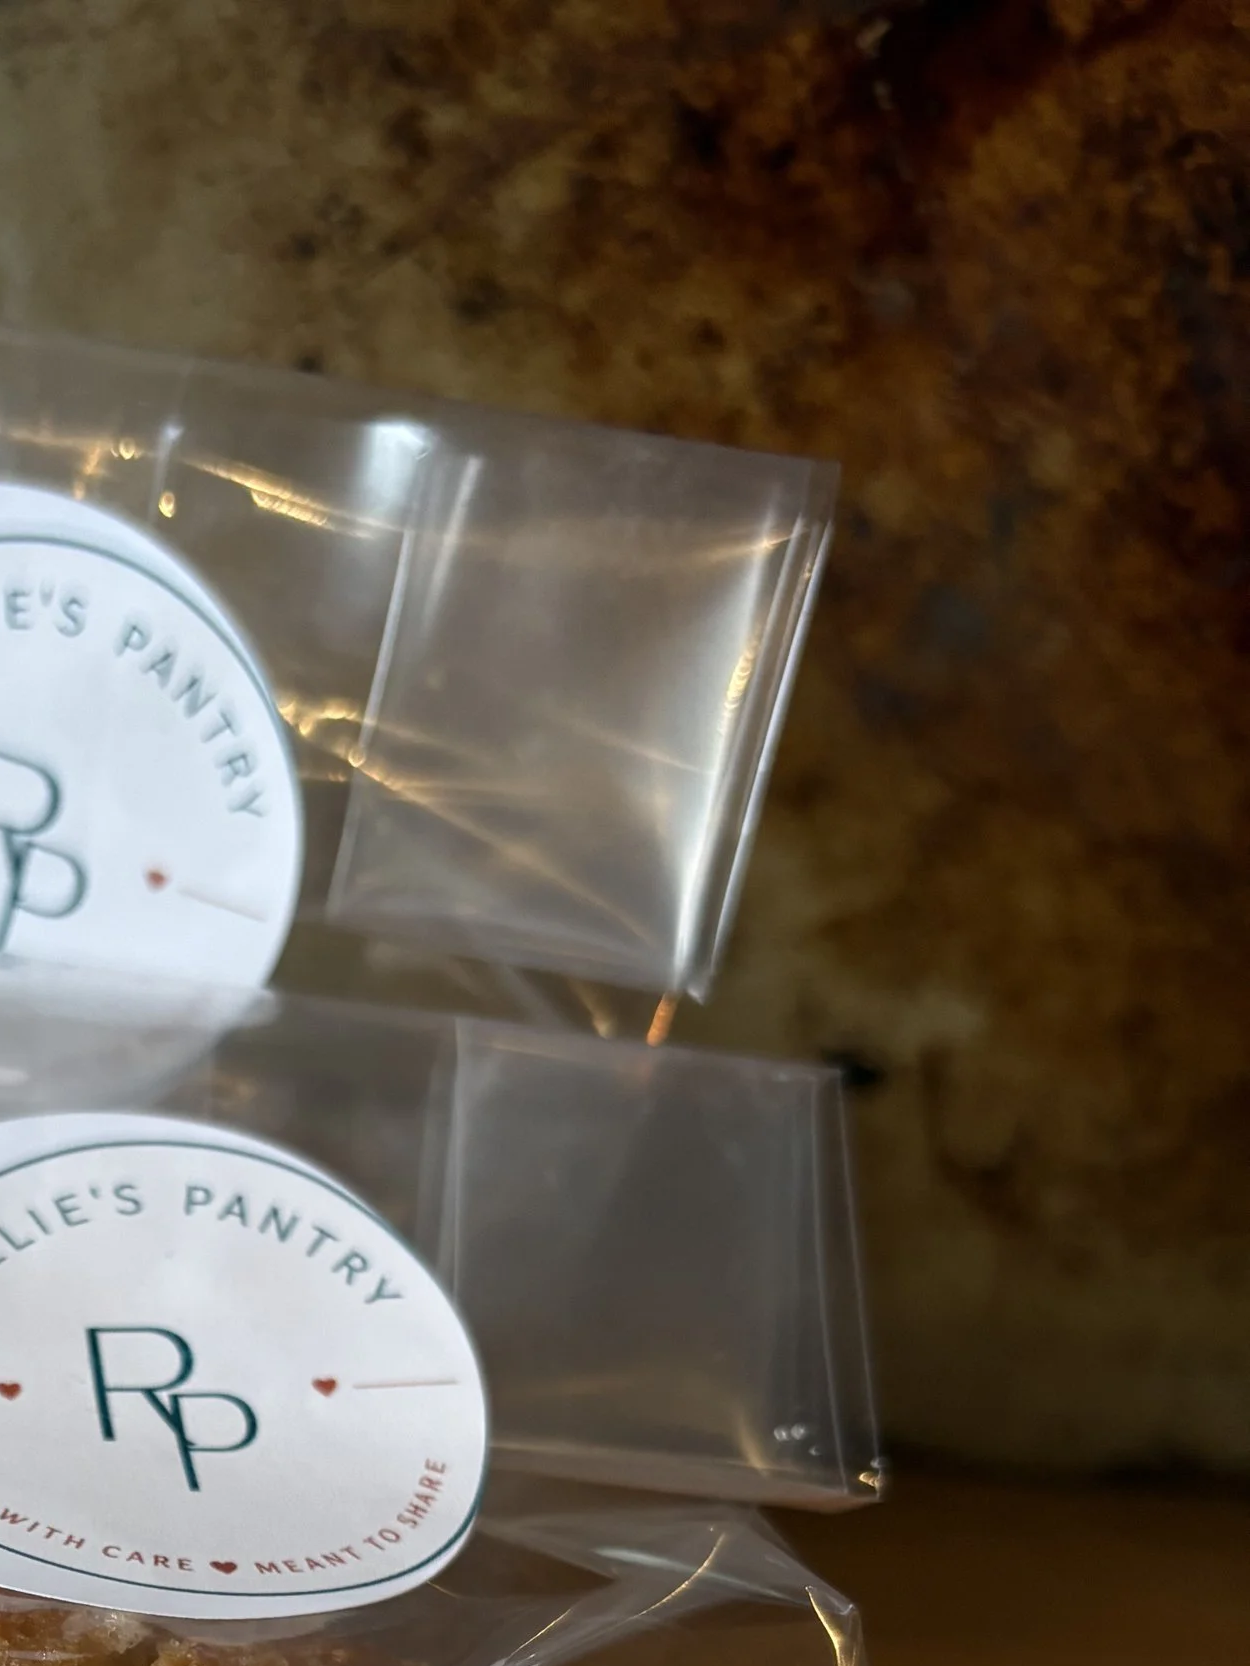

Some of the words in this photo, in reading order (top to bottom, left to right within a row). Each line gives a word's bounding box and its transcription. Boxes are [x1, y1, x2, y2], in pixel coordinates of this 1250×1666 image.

[113, 623, 268, 819] PANTRY
[183, 1184, 403, 1307] PANTRY
[101, 1544, 196, 1572] CARE
[253, 1546, 362, 1575] MEANT
[362, 1527, 402, 1551] TO
[396, 1457, 447, 1529] SHARE
